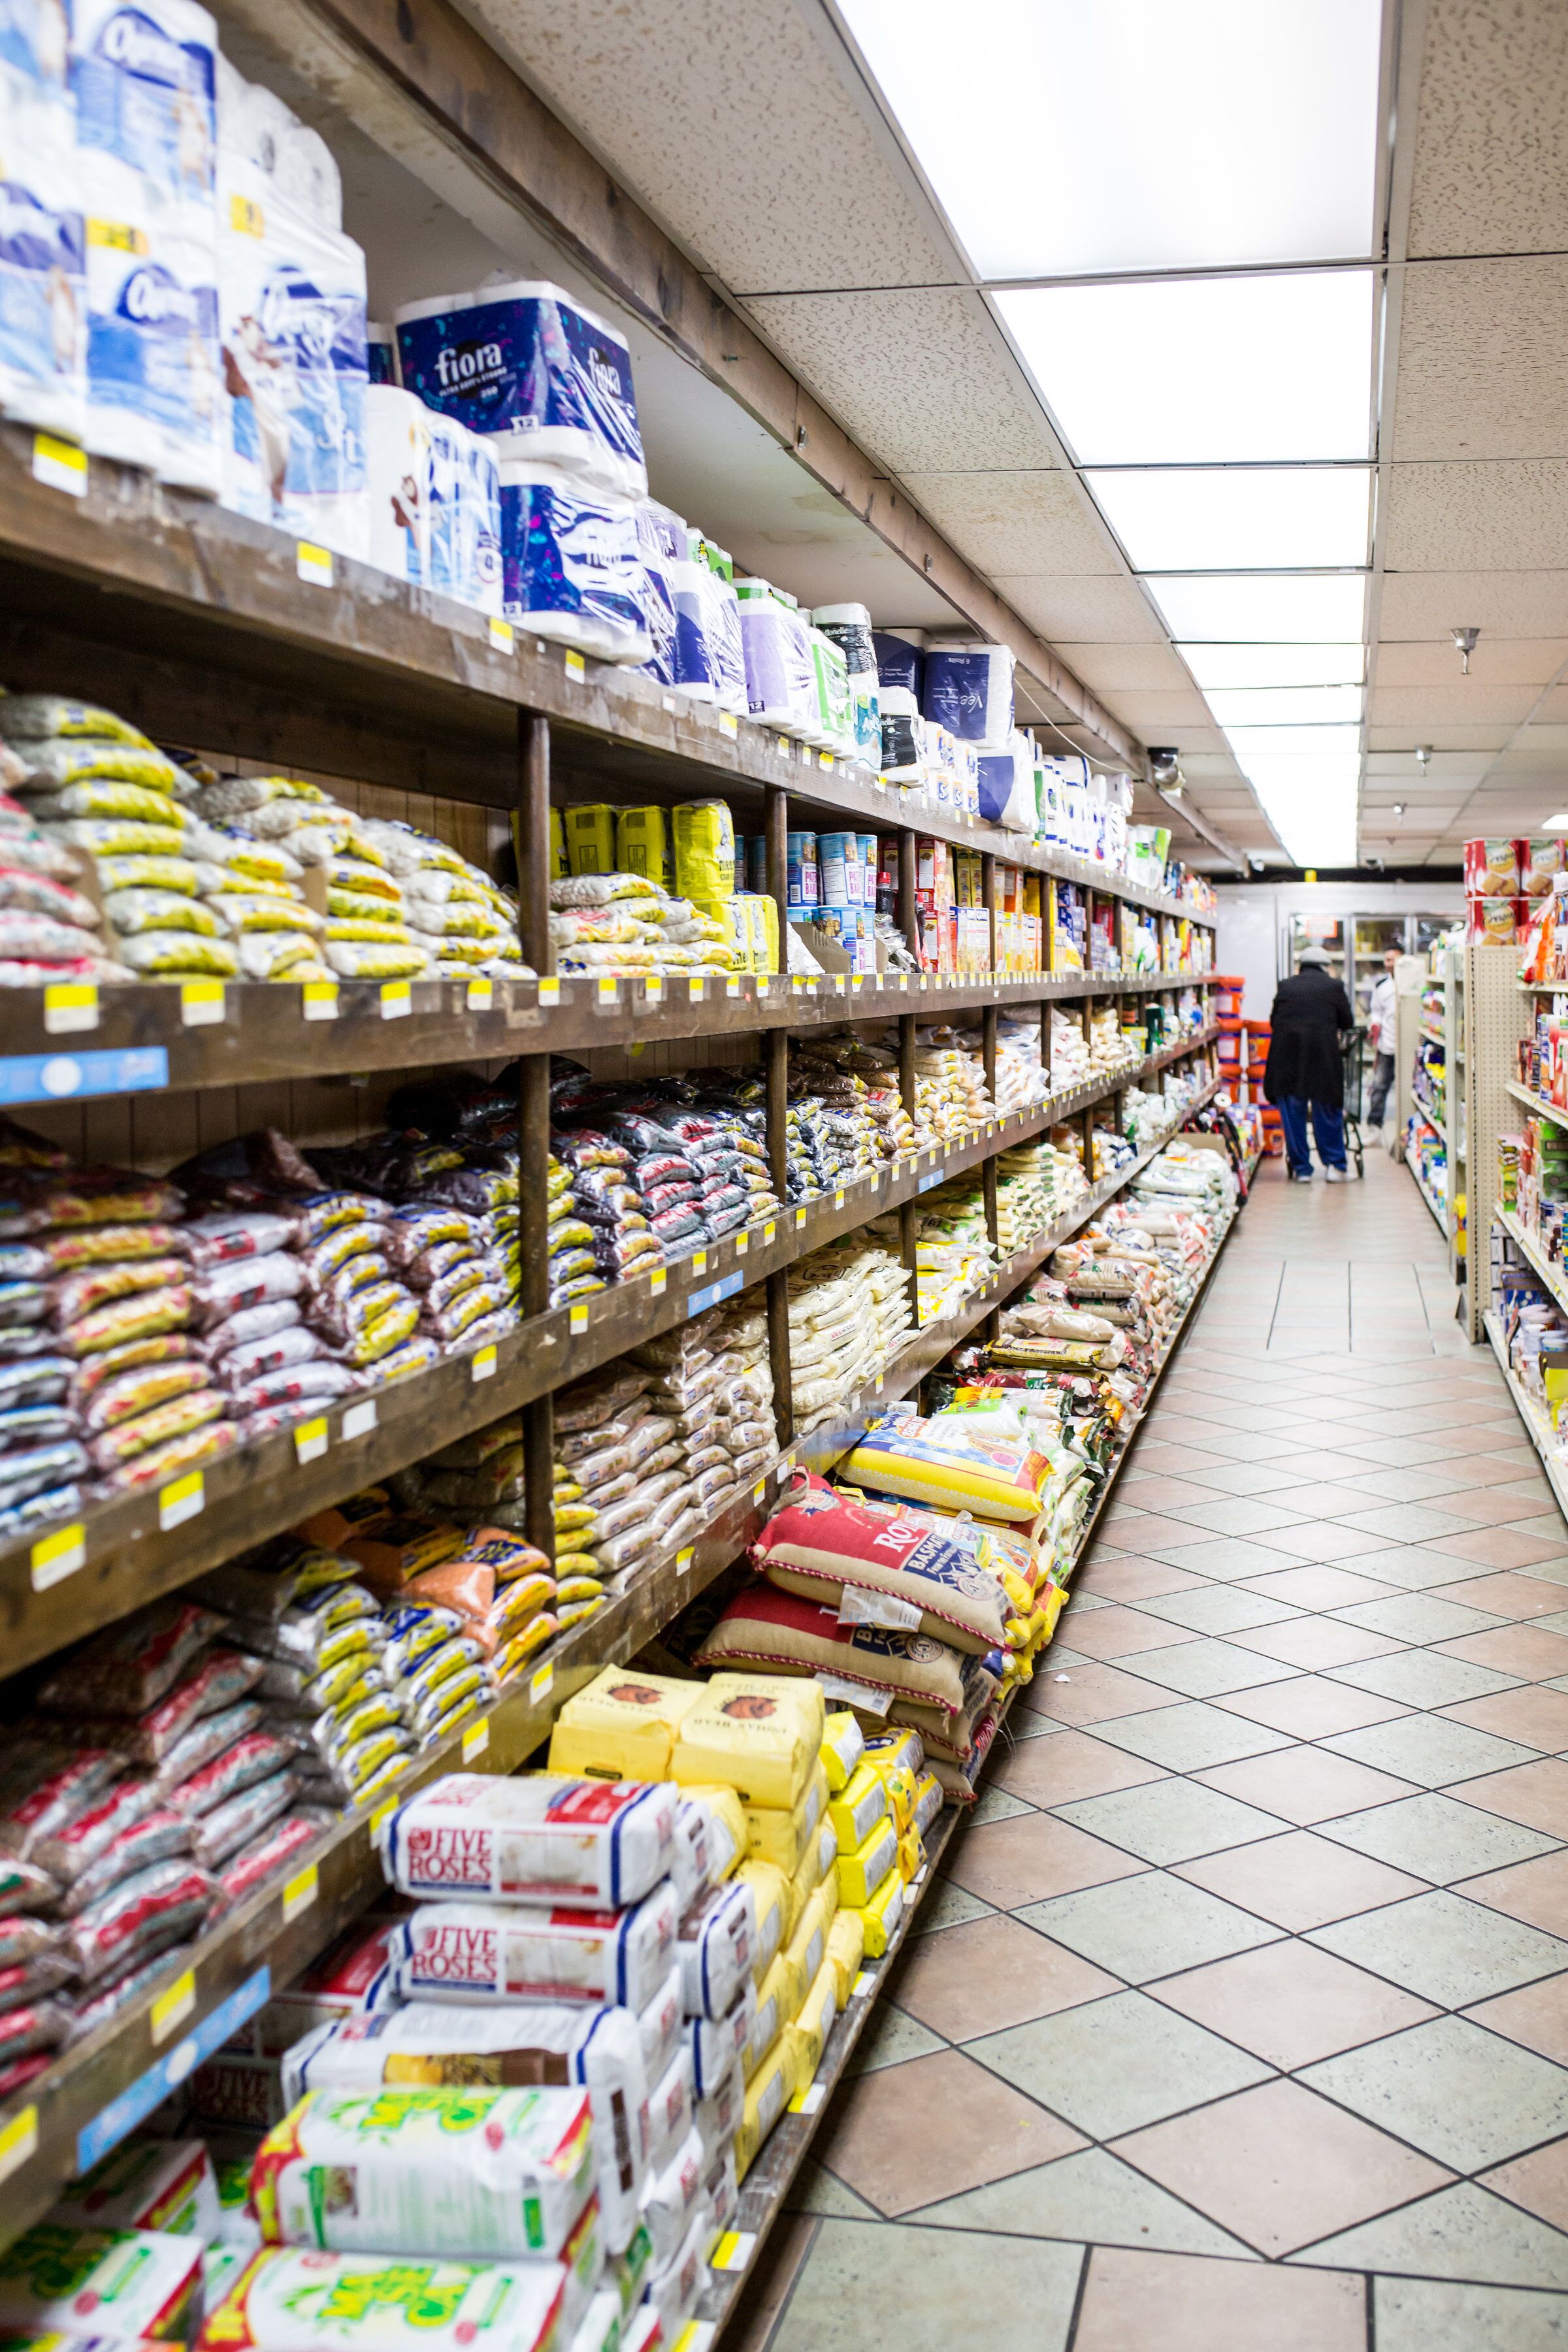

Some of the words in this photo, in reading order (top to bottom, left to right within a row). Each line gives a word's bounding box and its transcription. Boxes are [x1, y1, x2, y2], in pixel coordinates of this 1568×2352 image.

[434, 344, 502, 387] fiora
[748, 701, 763, 710] 12
[434, 1829, 493, 1854] FIVE
[407, 1855, 493, 1882] ROSES
[440, 1927, 498, 1955] FIVE
[412, 1953, 498, 1980] ROSES
